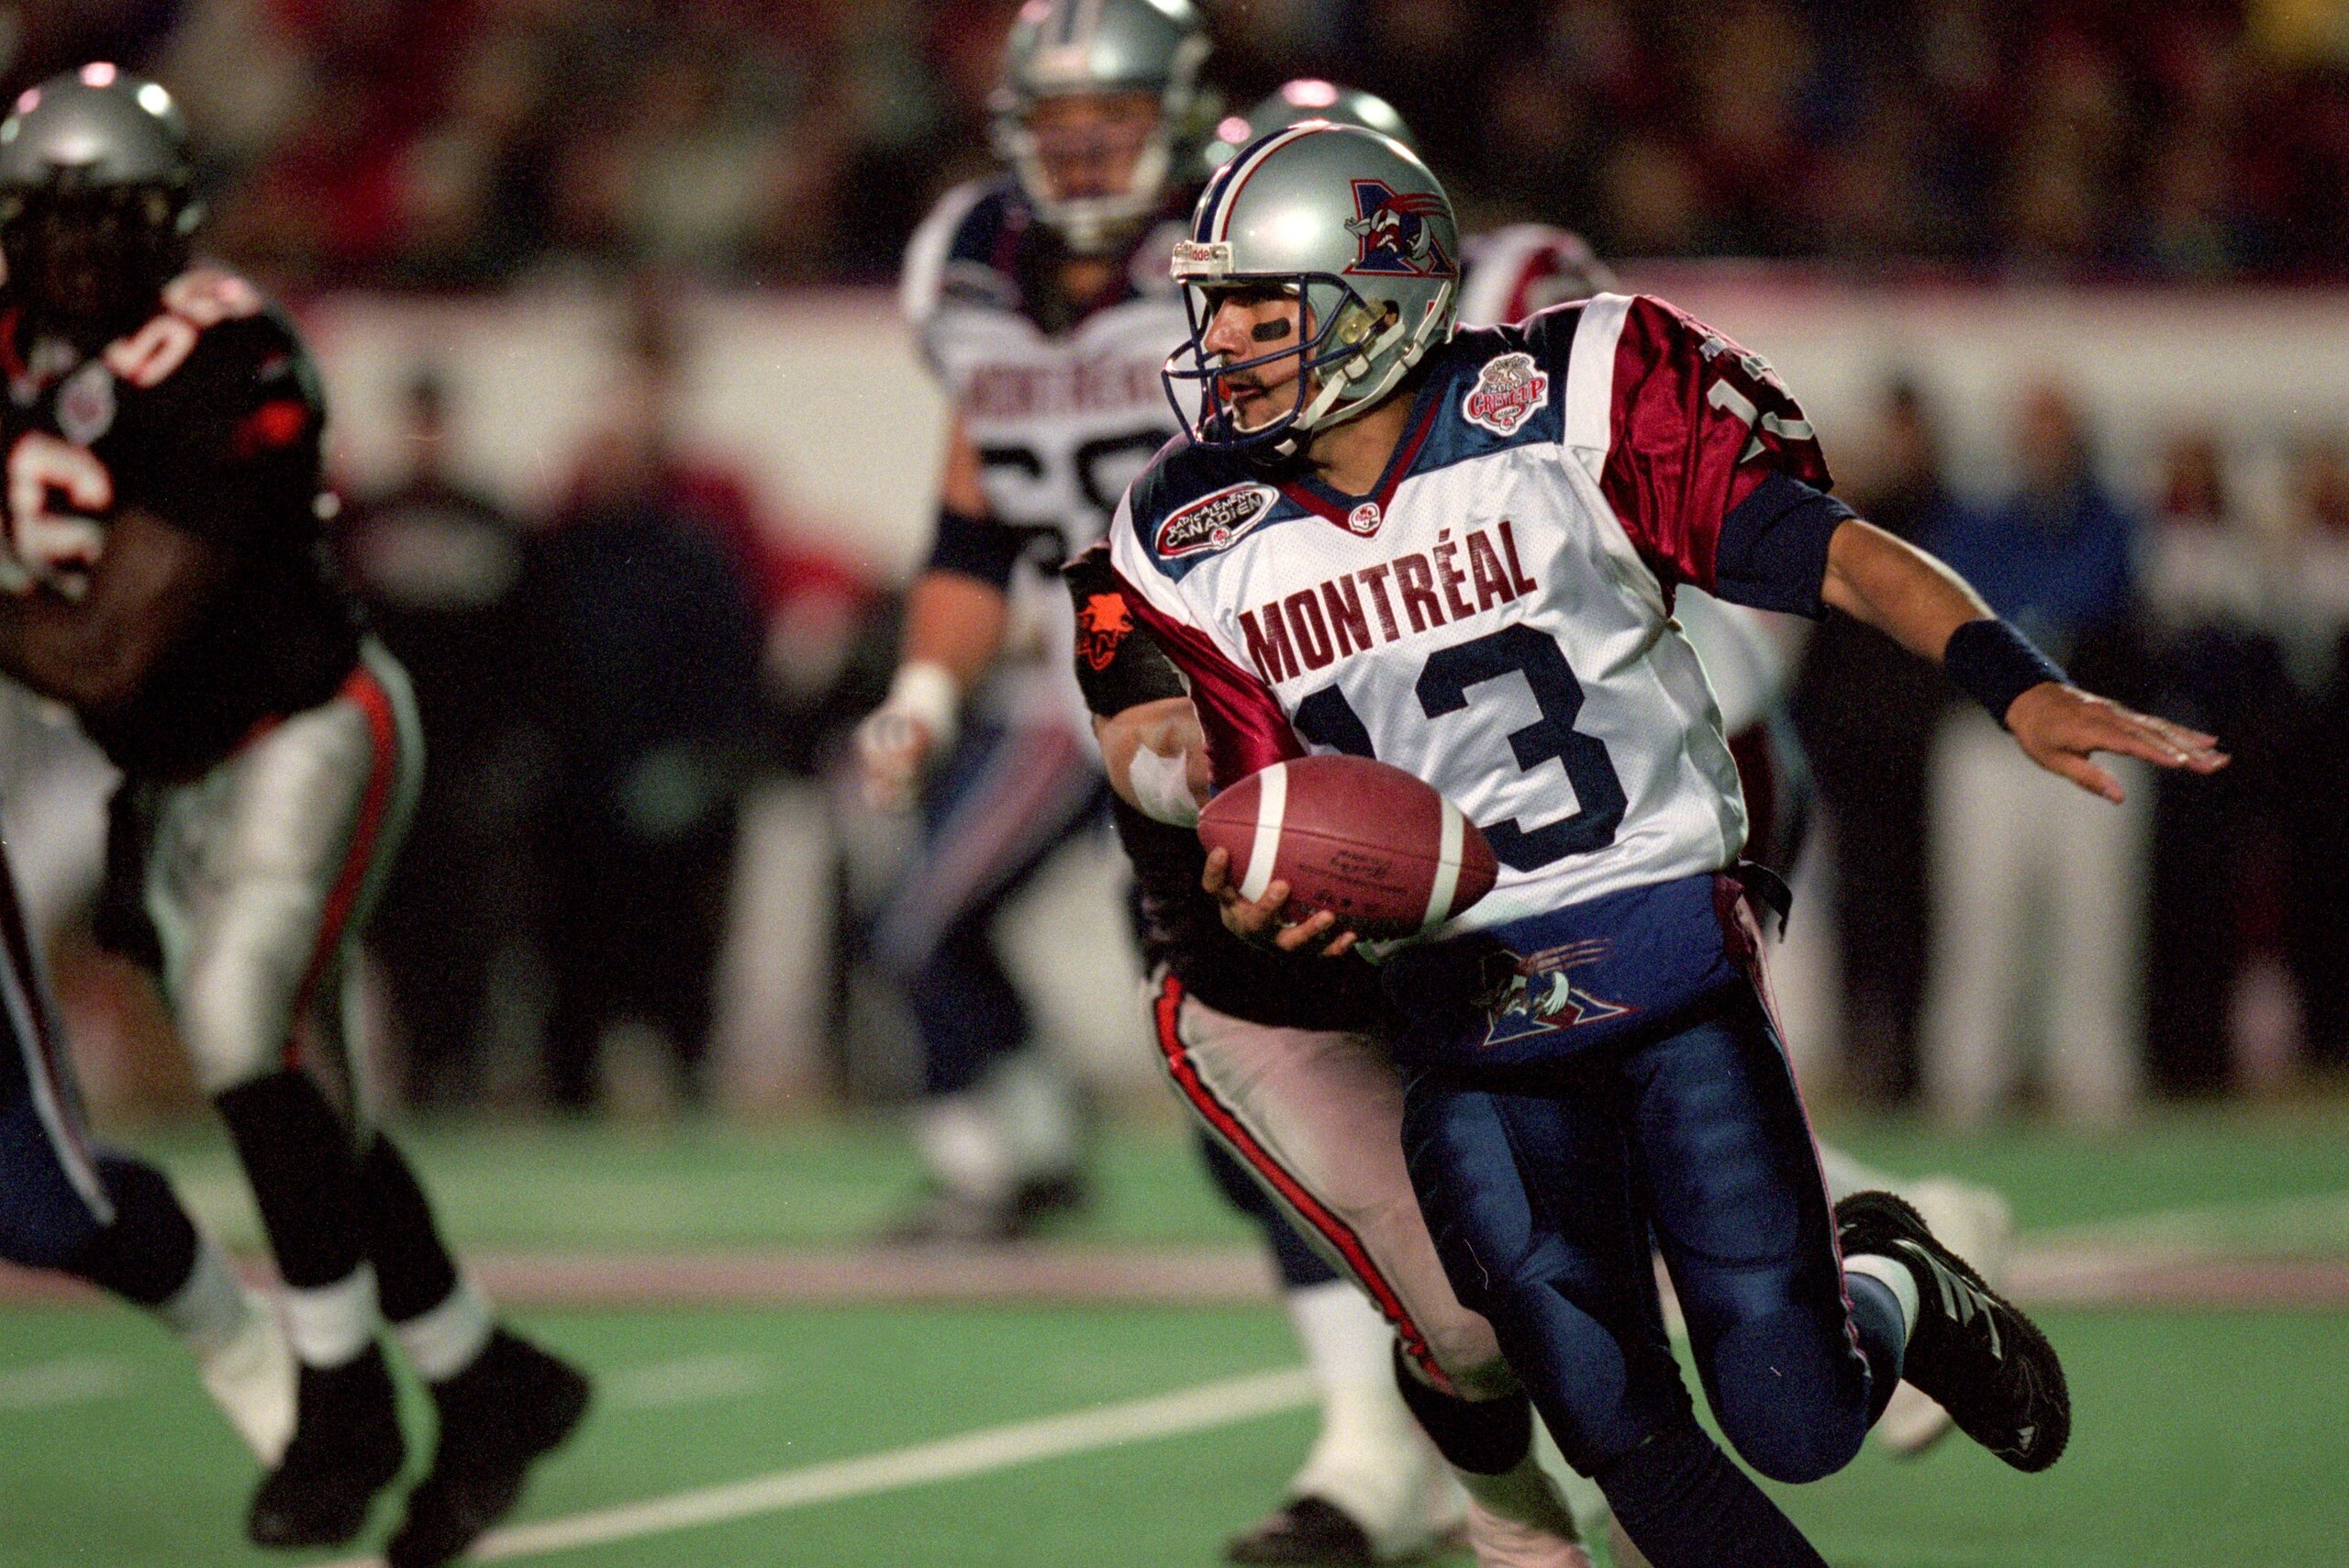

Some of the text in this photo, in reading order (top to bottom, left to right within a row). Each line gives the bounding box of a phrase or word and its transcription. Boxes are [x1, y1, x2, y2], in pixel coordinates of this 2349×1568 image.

[1468, 377, 1546, 418] GREY CUP
[1239, 521, 1538, 685] MONTRÉAL
